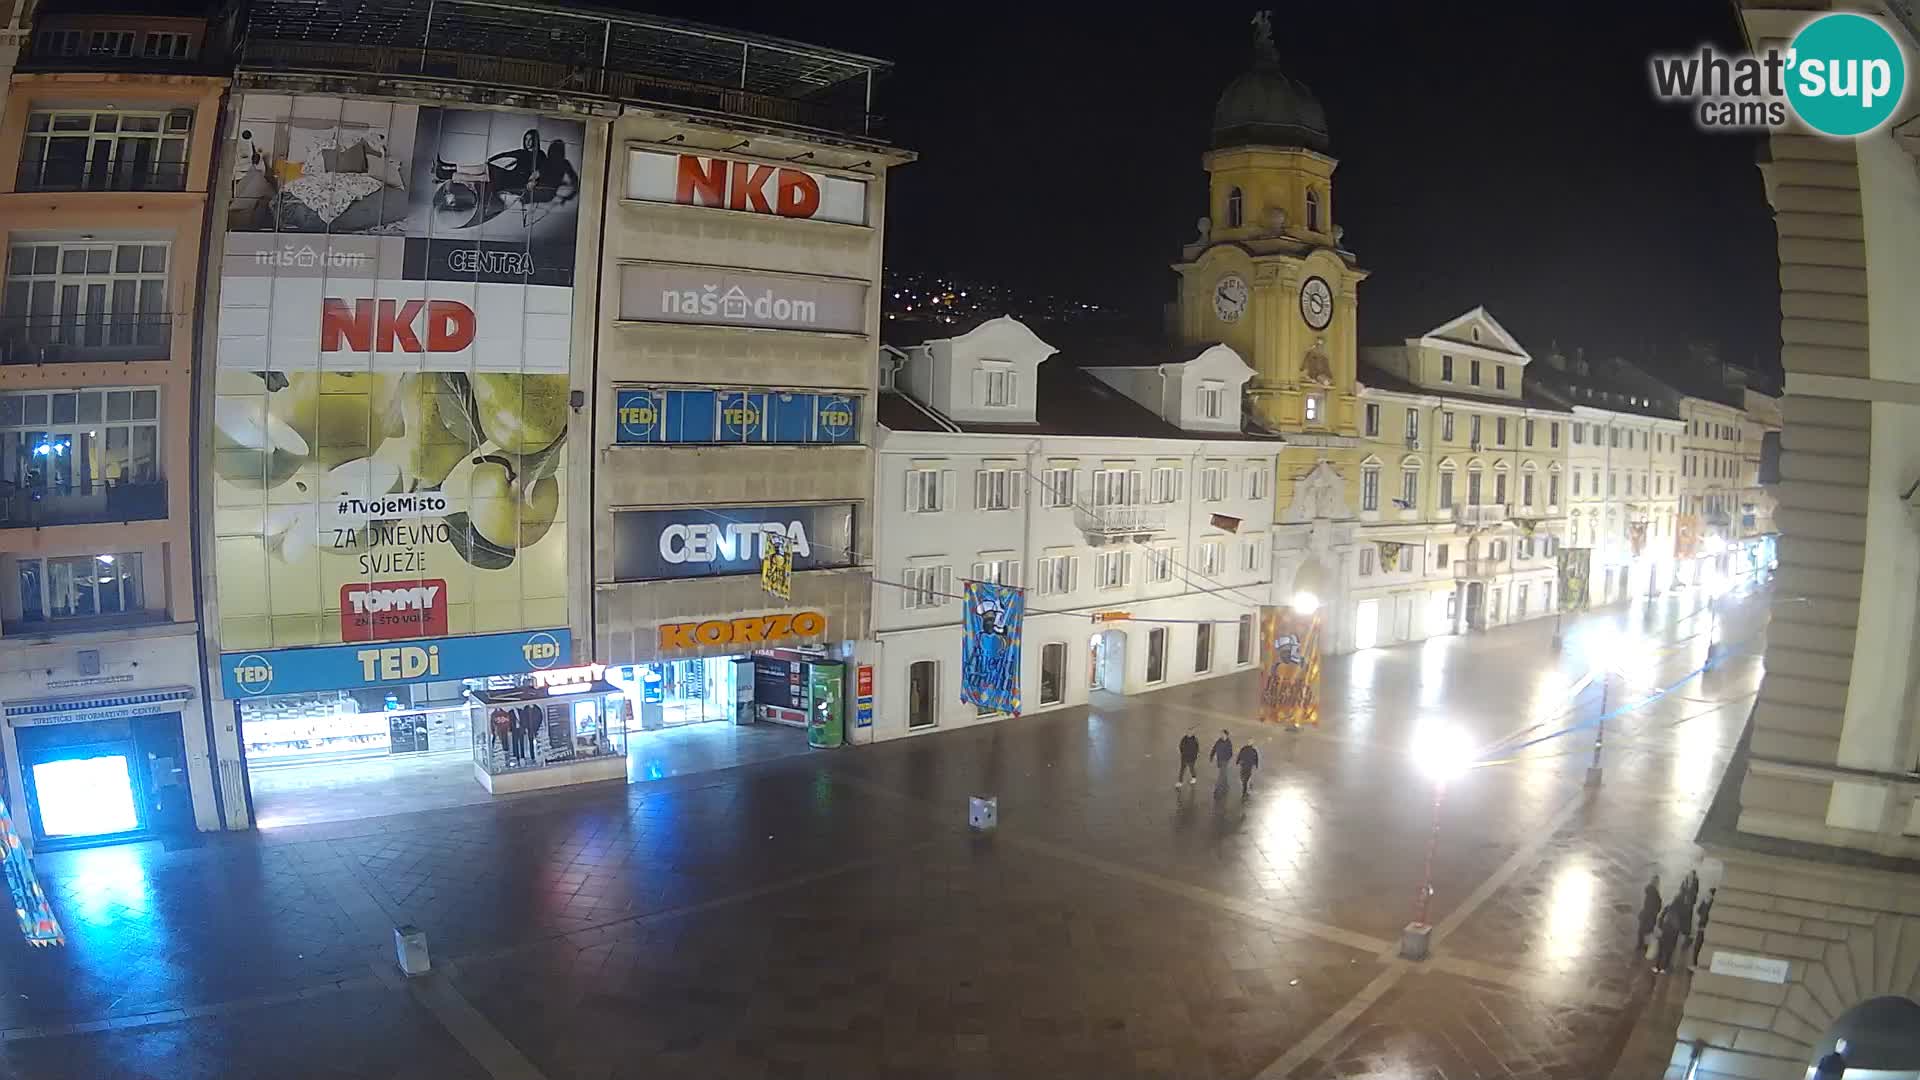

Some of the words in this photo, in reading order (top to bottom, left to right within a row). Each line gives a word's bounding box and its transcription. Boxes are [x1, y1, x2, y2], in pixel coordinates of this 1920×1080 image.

[676, 154, 820, 218] NKD
[320, 246, 366, 268] dom
[447, 249, 535, 275] CENTRA
[661, 284, 717, 316] naš
[754, 290, 816, 322] dom
[320, 297, 477, 354] NKD
[337, 496, 446, 516] #TvojeMisto
[333, 527, 358, 549] ZA
[368, 523, 451, 548] DNEVNO
[659, 520, 810, 564] CENTRA
[359, 546, 426, 575] SVJEŽE
[348, 586, 439, 614] TOMMY
[657, 611, 826, 650] KORZO
[358, 645, 439, 682] TEDi
[522, 641, 561, 660] TEDi
[234, 664, 273, 684] TEDi
